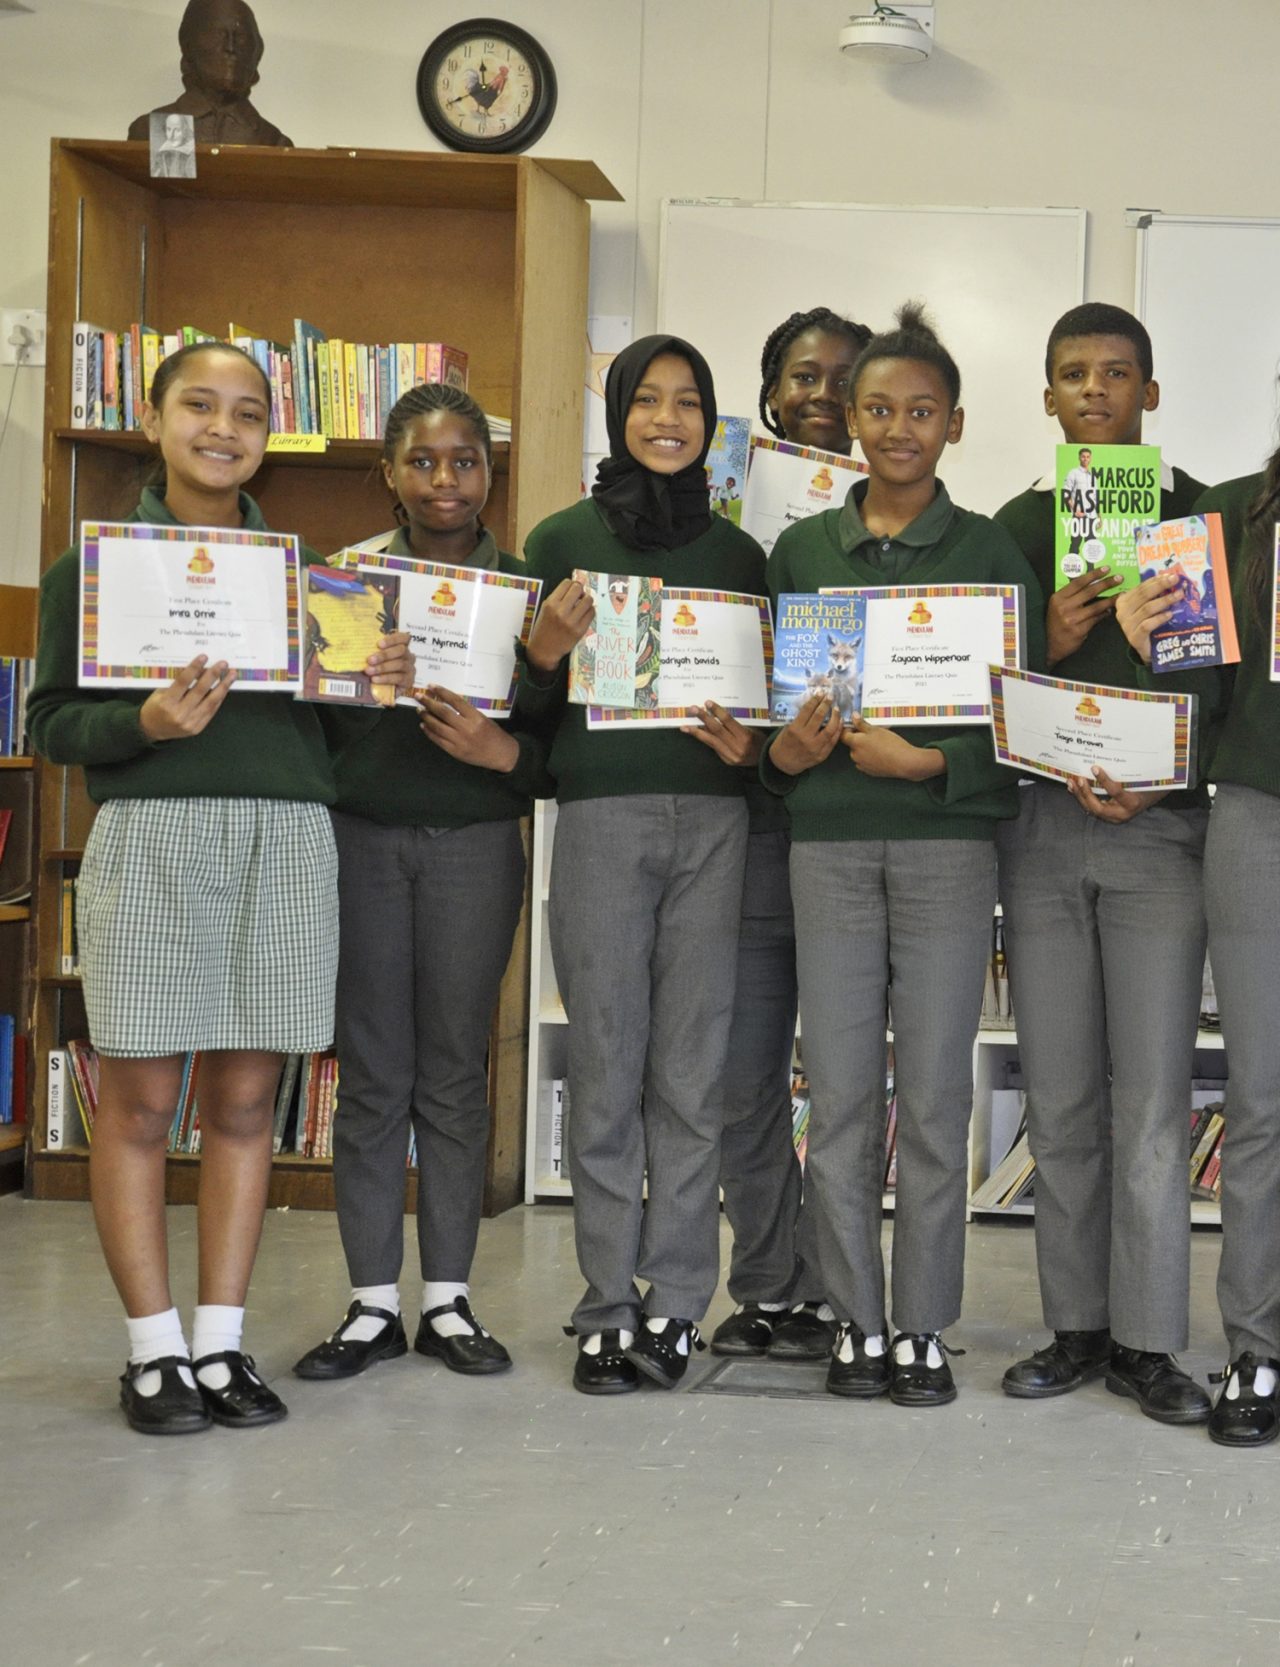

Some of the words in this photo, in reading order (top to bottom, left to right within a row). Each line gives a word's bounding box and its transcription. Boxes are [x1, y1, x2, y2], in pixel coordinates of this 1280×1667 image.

[75, 358, 83, 392] FICTION
[1091, 467, 1155, 489] MARCUS
[1060, 489, 1155, 514] RASHFORD
[1061, 517, 1090, 538] YOU
[1092, 517, 1119, 538] CAN
[787, 601, 855, 617] michael
[781, 617, 864, 635] morpurgo
[596, 634, 635, 653] RIVER
[797, 633, 819, 643] FOX
[1156, 636, 1181, 653] GREG
[1190, 633, 1215, 646] CHRIS
[694, 656, 720, 665] Davids
[781, 648, 821, 658] GHOST
[891, 654, 922, 665] Zayaan
[1157, 647, 1185, 665] JAMES
[1190, 645, 1217, 658] SMITH
[596, 660, 633, 681] BOOK
[786, 658, 816, 668] KING
[50, 1057, 60, 1071] S
[51, 1083, 59, 1117] FICTION
[50, 1129, 59, 1142] S
